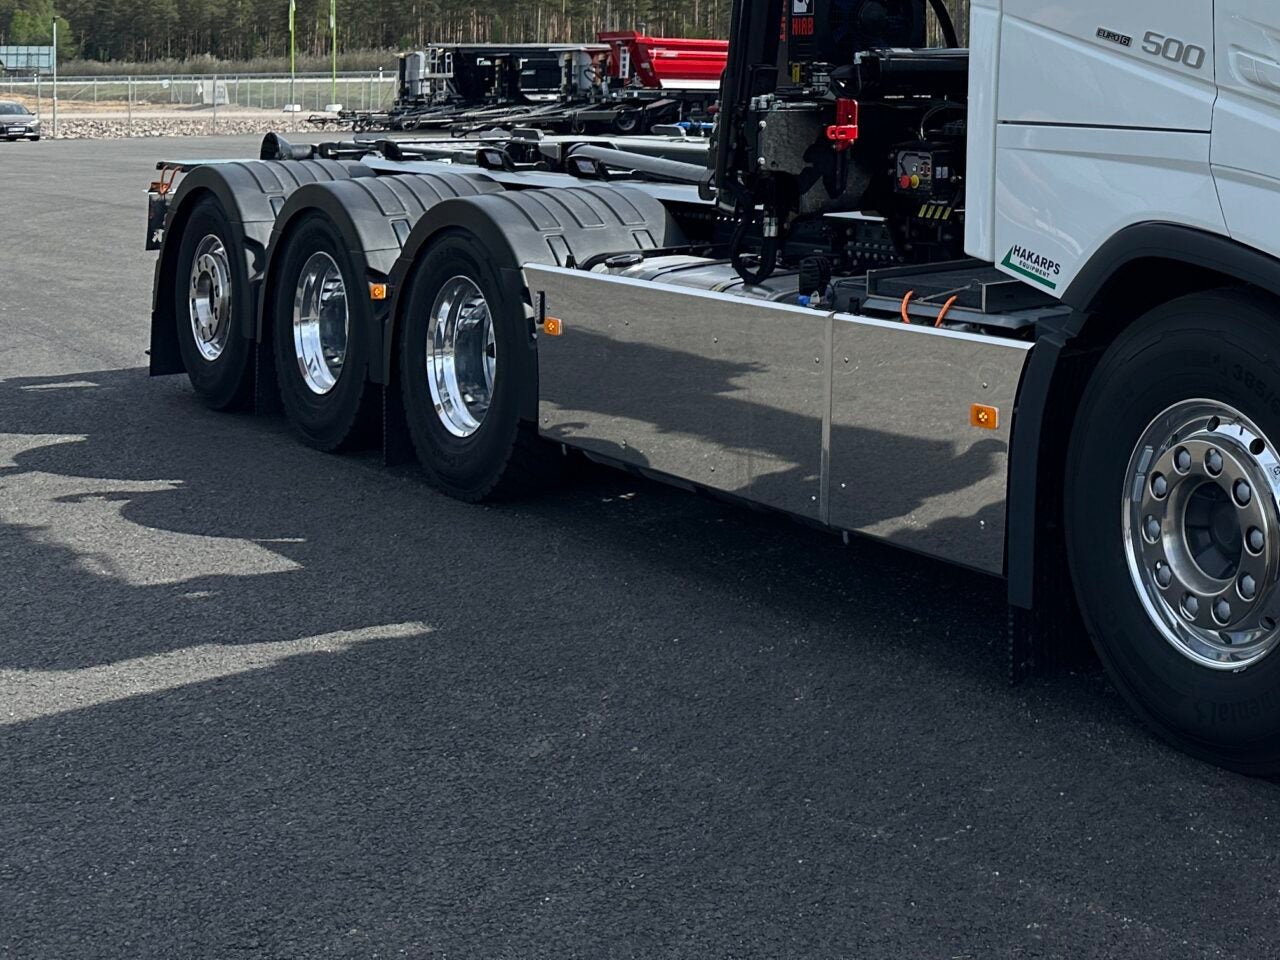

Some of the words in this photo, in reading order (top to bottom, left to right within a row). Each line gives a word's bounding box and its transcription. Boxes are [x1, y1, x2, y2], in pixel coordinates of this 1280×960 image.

[792, 17, 814, 35] HIAB
[1142, 31, 1205, 69] 500
[1013, 245, 1061, 275] HAKARPS
[1019, 261, 1050, 278] EQUIPMENT
